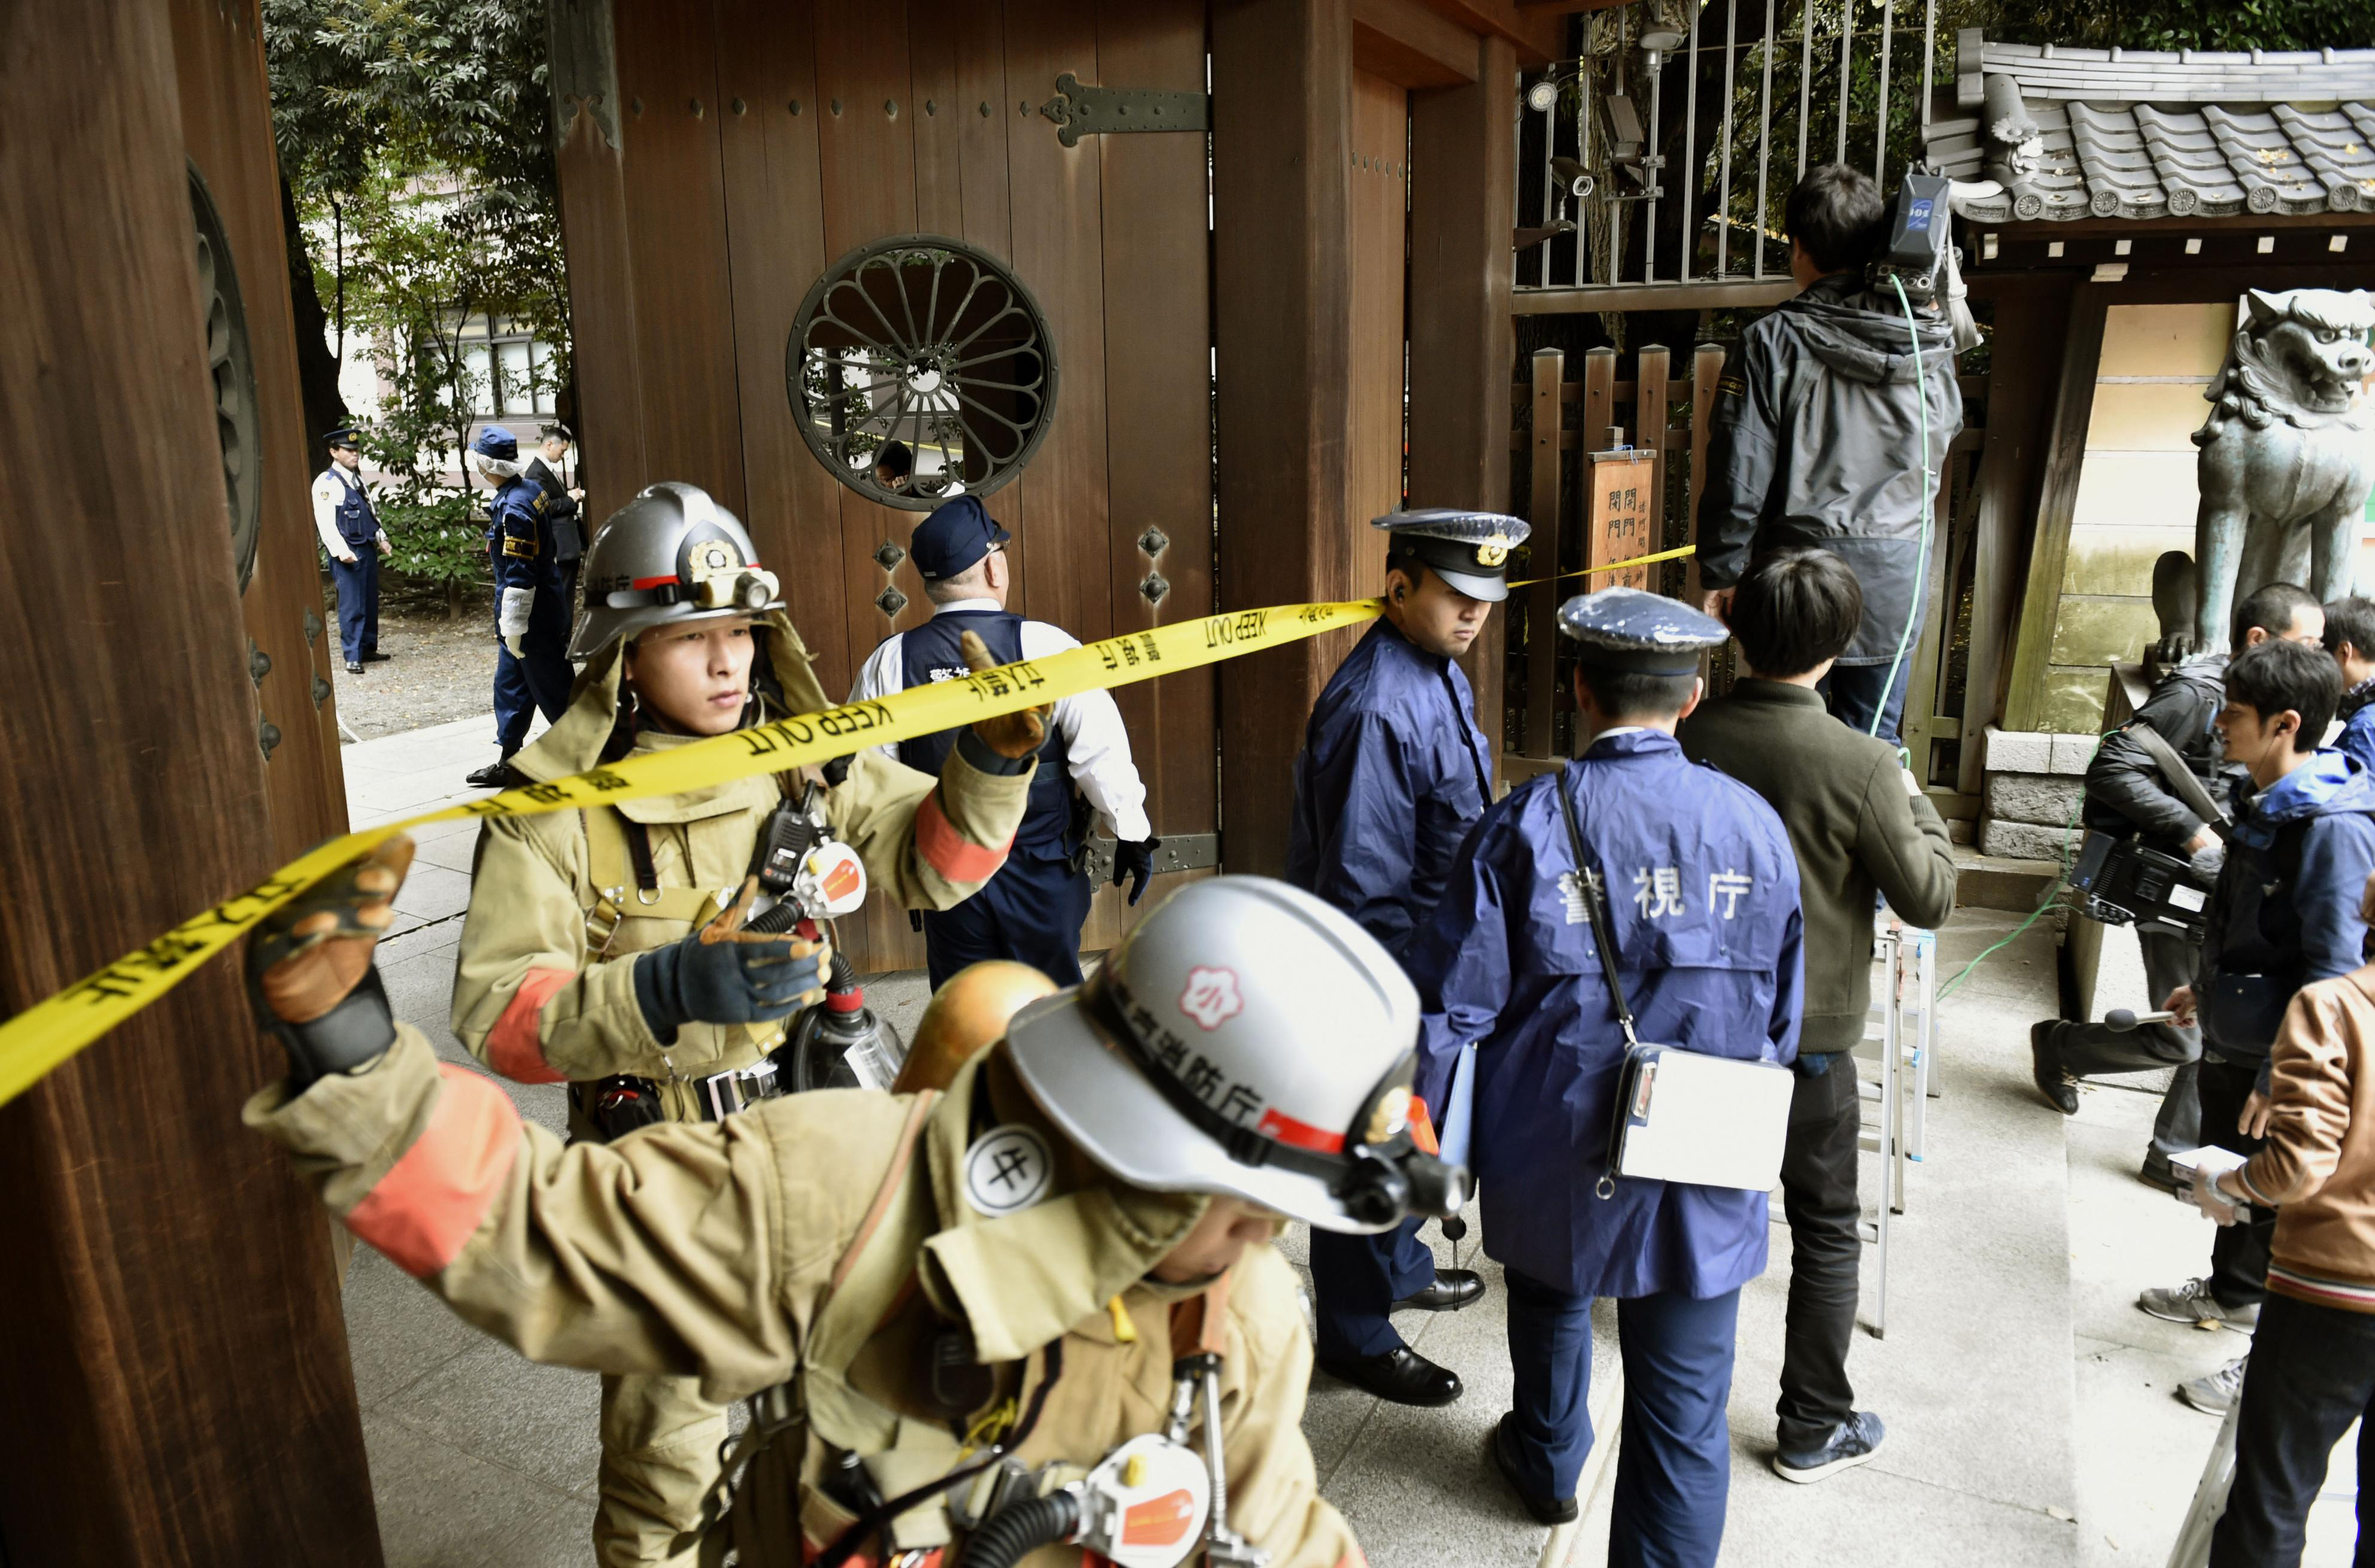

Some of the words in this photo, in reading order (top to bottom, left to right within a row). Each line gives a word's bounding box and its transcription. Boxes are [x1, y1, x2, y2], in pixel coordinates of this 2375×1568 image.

[1623, 487, 1637, 537] 開門
[1204, 616, 1232, 649] OUT
[1235, 610, 1268, 640] KEEP
[956, 662, 1045, 702] 立入禁止
[818, 701, 894, 737] KEEP
[737, 721, 813, 756] OUT
